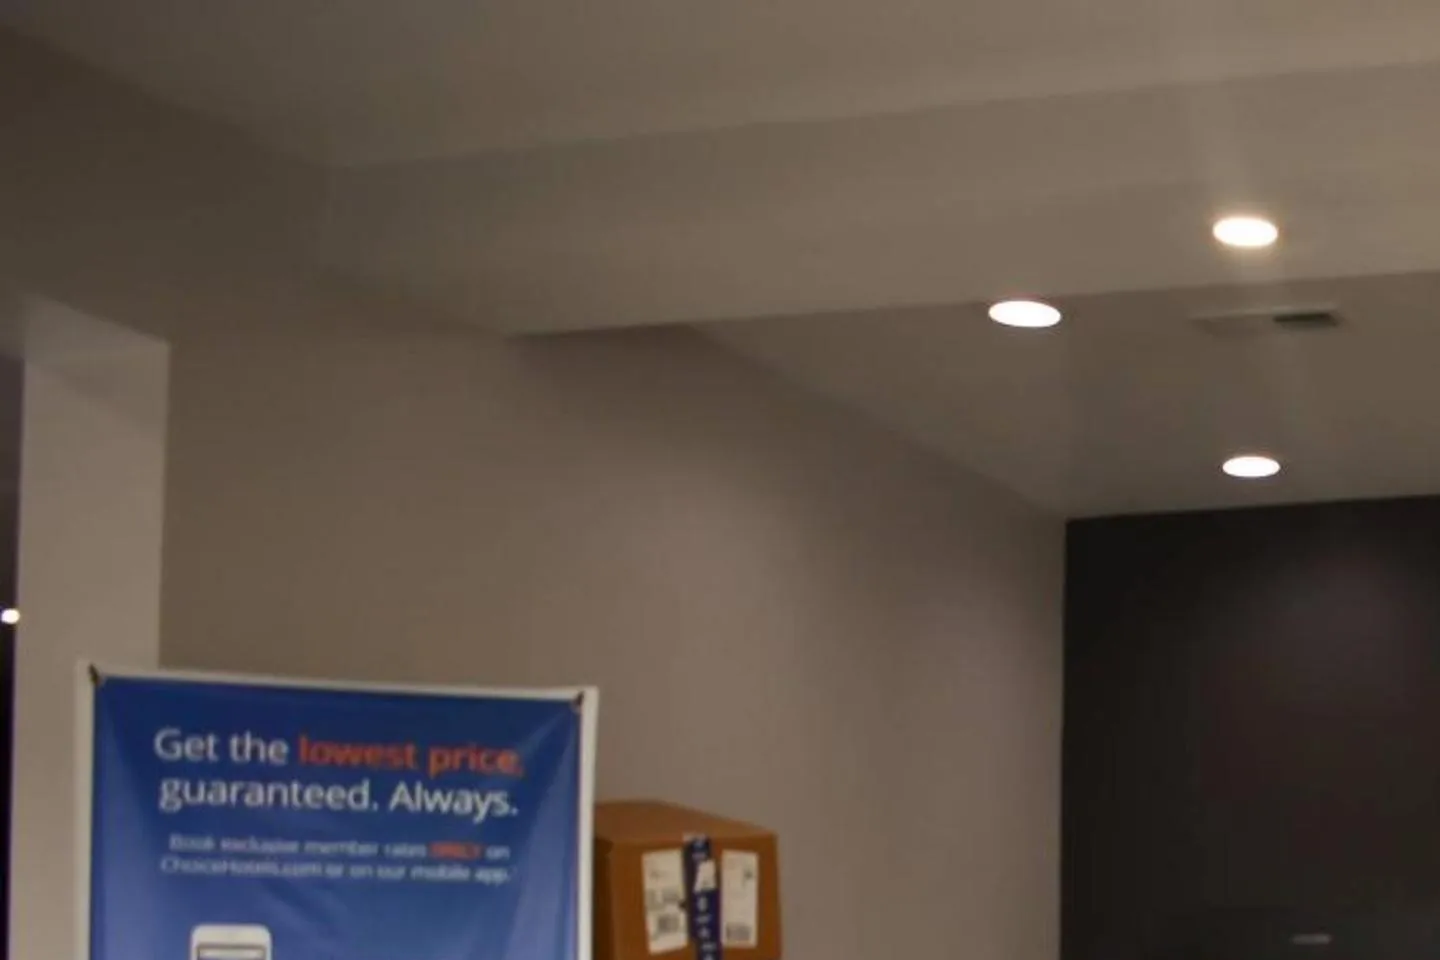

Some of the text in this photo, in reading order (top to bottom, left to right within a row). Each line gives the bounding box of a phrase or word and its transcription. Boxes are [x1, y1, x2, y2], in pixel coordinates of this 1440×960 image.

[153, 727, 218, 763] Get
[229, 730, 289, 766] the
[298, 733, 419, 771] lowest
[158, 777, 519, 825] guaranteed. Always.
